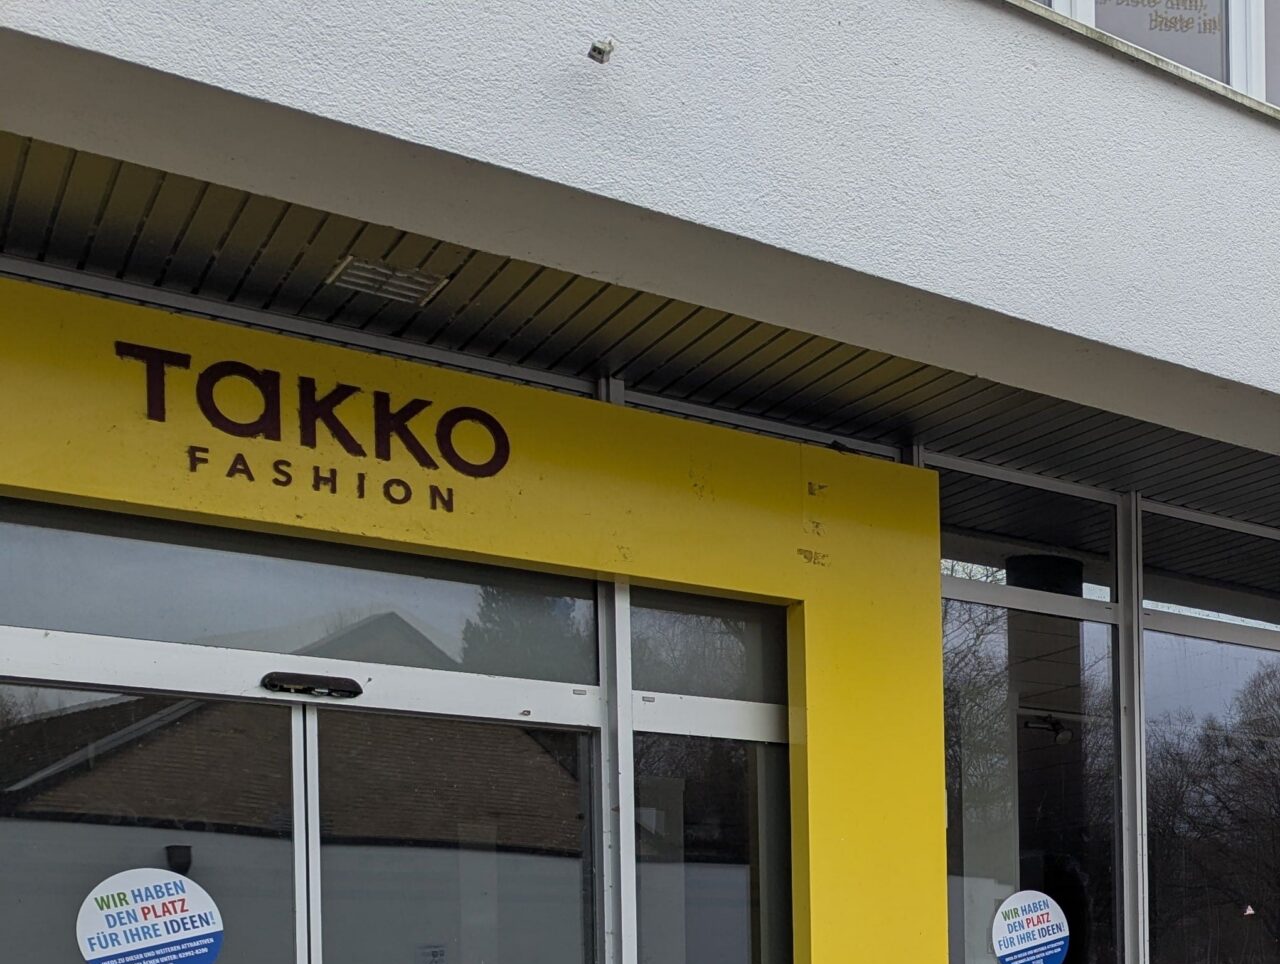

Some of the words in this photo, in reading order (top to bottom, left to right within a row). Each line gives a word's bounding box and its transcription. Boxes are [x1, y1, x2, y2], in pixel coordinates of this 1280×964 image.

[187, 445, 455, 513] FASHION
[94, 891, 130, 912] WIR
[130, 879, 187, 904] HABEN
[1001, 907, 1021, 922] WIR
[1020, 899, 1051, 917] HABEN
[104, 908, 140, 929] DEN
[141, 898, 189, 921] PLATZ
[1007, 920, 1025, 934] DEN
[1025, 912, 1052, 929] PLATZ
[87, 931, 122, 952] FÜR
[123, 923, 163, 945] IHRE
[163, 911, 217, 936] IDEEN!
[998, 935, 1016, 951] FÜR
[1016, 929, 1038, 945] IHRE
[1037, 922, 1066, 938] IDEEN!
